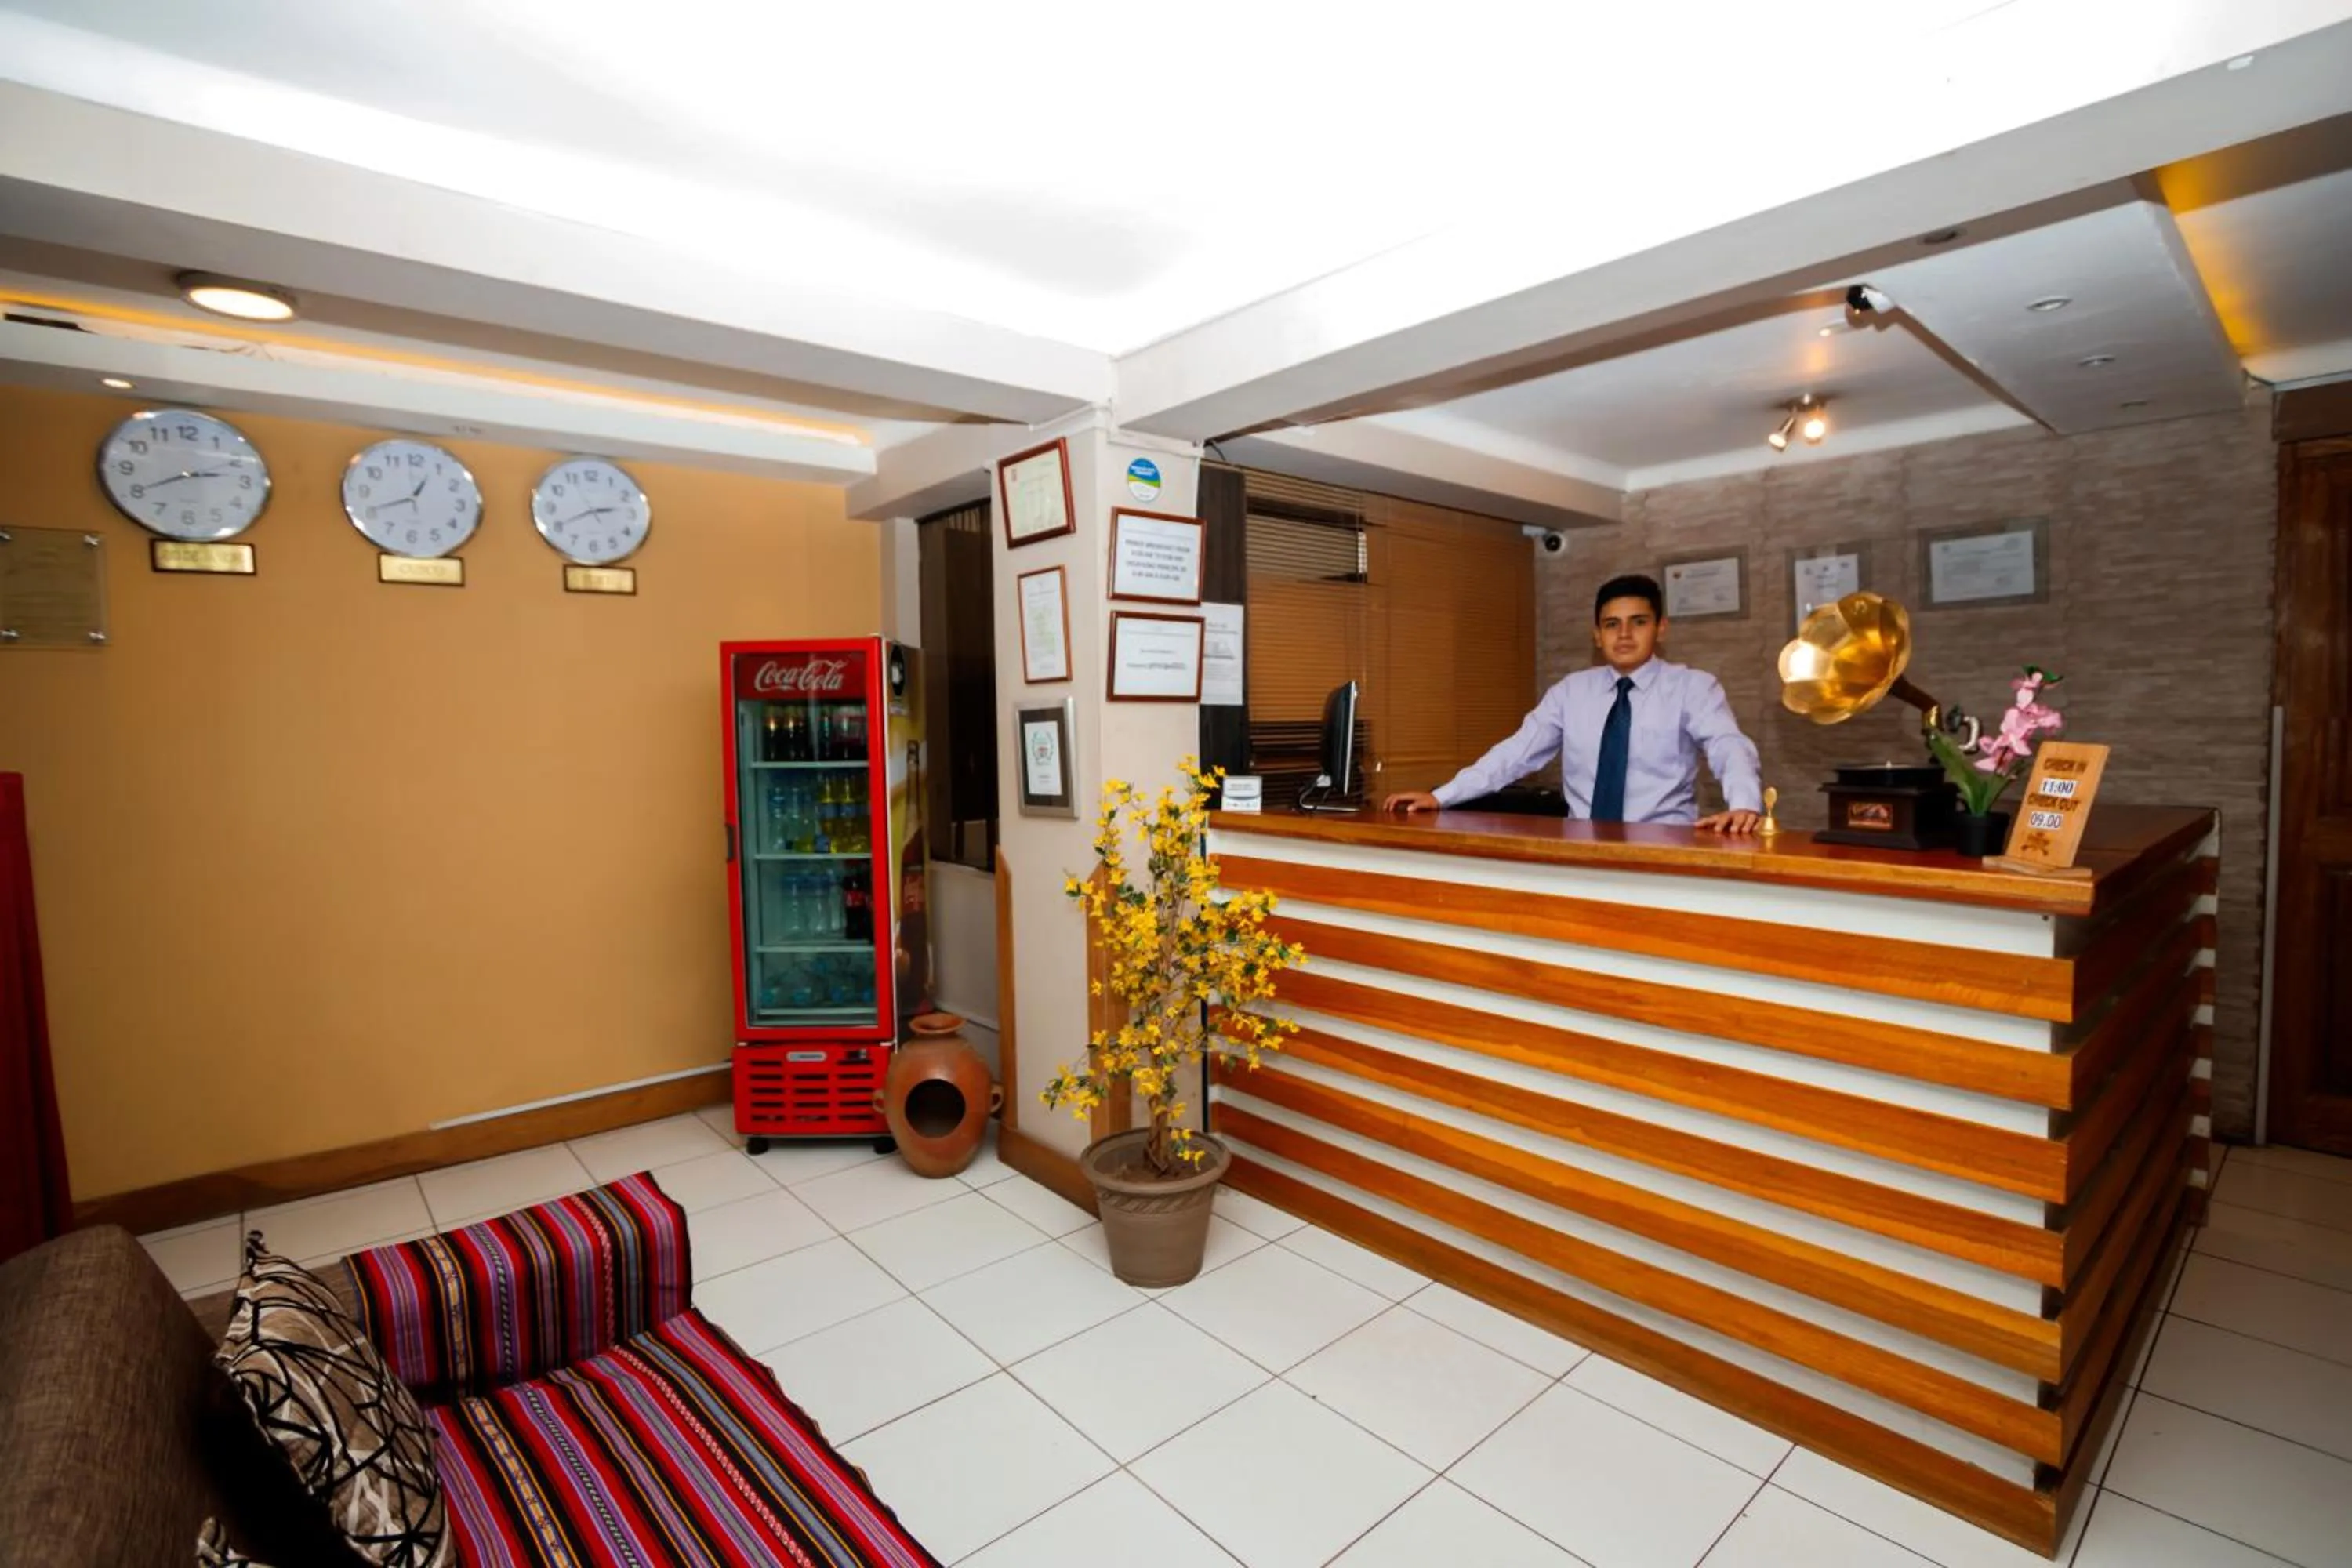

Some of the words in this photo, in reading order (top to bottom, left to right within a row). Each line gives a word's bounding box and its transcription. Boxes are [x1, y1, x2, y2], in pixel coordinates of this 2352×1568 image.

[151, 427, 169, 442] 11
[176, 426, 199, 441] 12
[129, 440, 148, 455] 10
[212, 436, 220, 449] 1
[118, 460, 134, 475] 9
[384, 454, 400, 468] 11
[407, 453, 425, 468] 12
[366, 466, 383, 481] 10
[435, 463, 442, 476] 1
[583, 470, 599, 483] 12
[239, 475, 252, 490] 3
[448, 478, 459, 492] 2
[565, 472, 579, 485] 11
[608, 476, 614, 488] 1
[130, 484, 145, 499] 8
[358, 484, 371, 499] 9
[551, 484, 565, 498] 10
[619, 489, 630, 503] 2
[151, 502, 167, 515] 7
[454, 499, 466, 513] 3
[181, 510, 196, 525] 6
[209, 508, 223, 523] 5
[384, 521, 395, 535] 7
[446, 517, 458, 530] 4
[406, 530, 418, 544] 6
[429, 528, 441, 542] 5
[569, 534, 579, 546] 7
[589, 539, 599, 554] 6
[608, 536, 619, 550] 5
[754, 660, 849, 692] Coca-Cola
[2043, 758, 2075, 771] CHECK
[2074, 760, 2088, 774] IN
[2043, 781, 2074, 793] 11:00
[2027, 793, 2058, 808] CHECK
[2058, 797, 2081, 812] OUT
